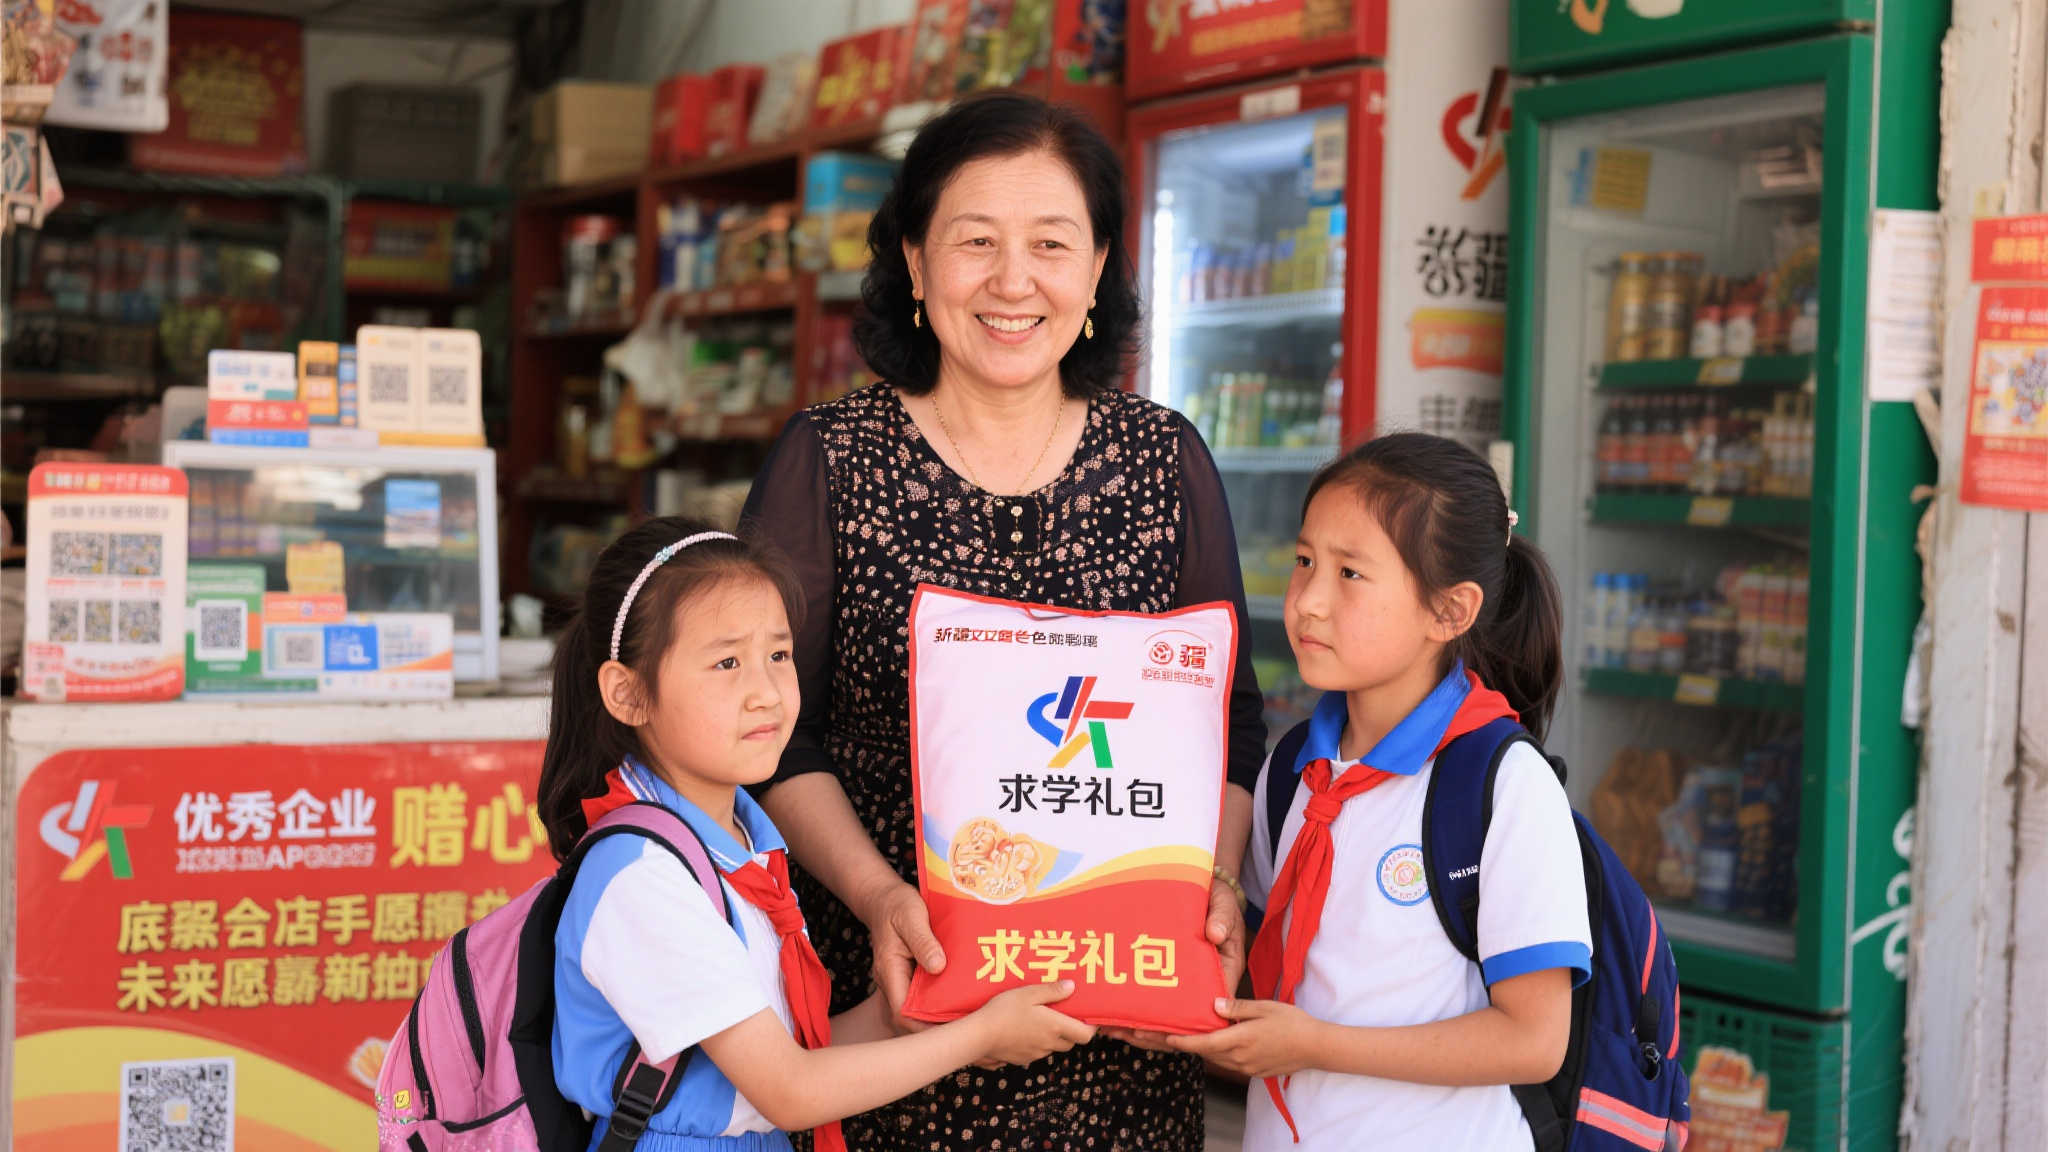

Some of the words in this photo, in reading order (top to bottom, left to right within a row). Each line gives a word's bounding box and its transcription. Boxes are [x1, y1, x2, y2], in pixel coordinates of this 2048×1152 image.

[174, 788, 377, 842] 优秀企业
[998, 773, 1166, 818] 求学礼包
[976, 929, 1179, 987] 求学礼包
